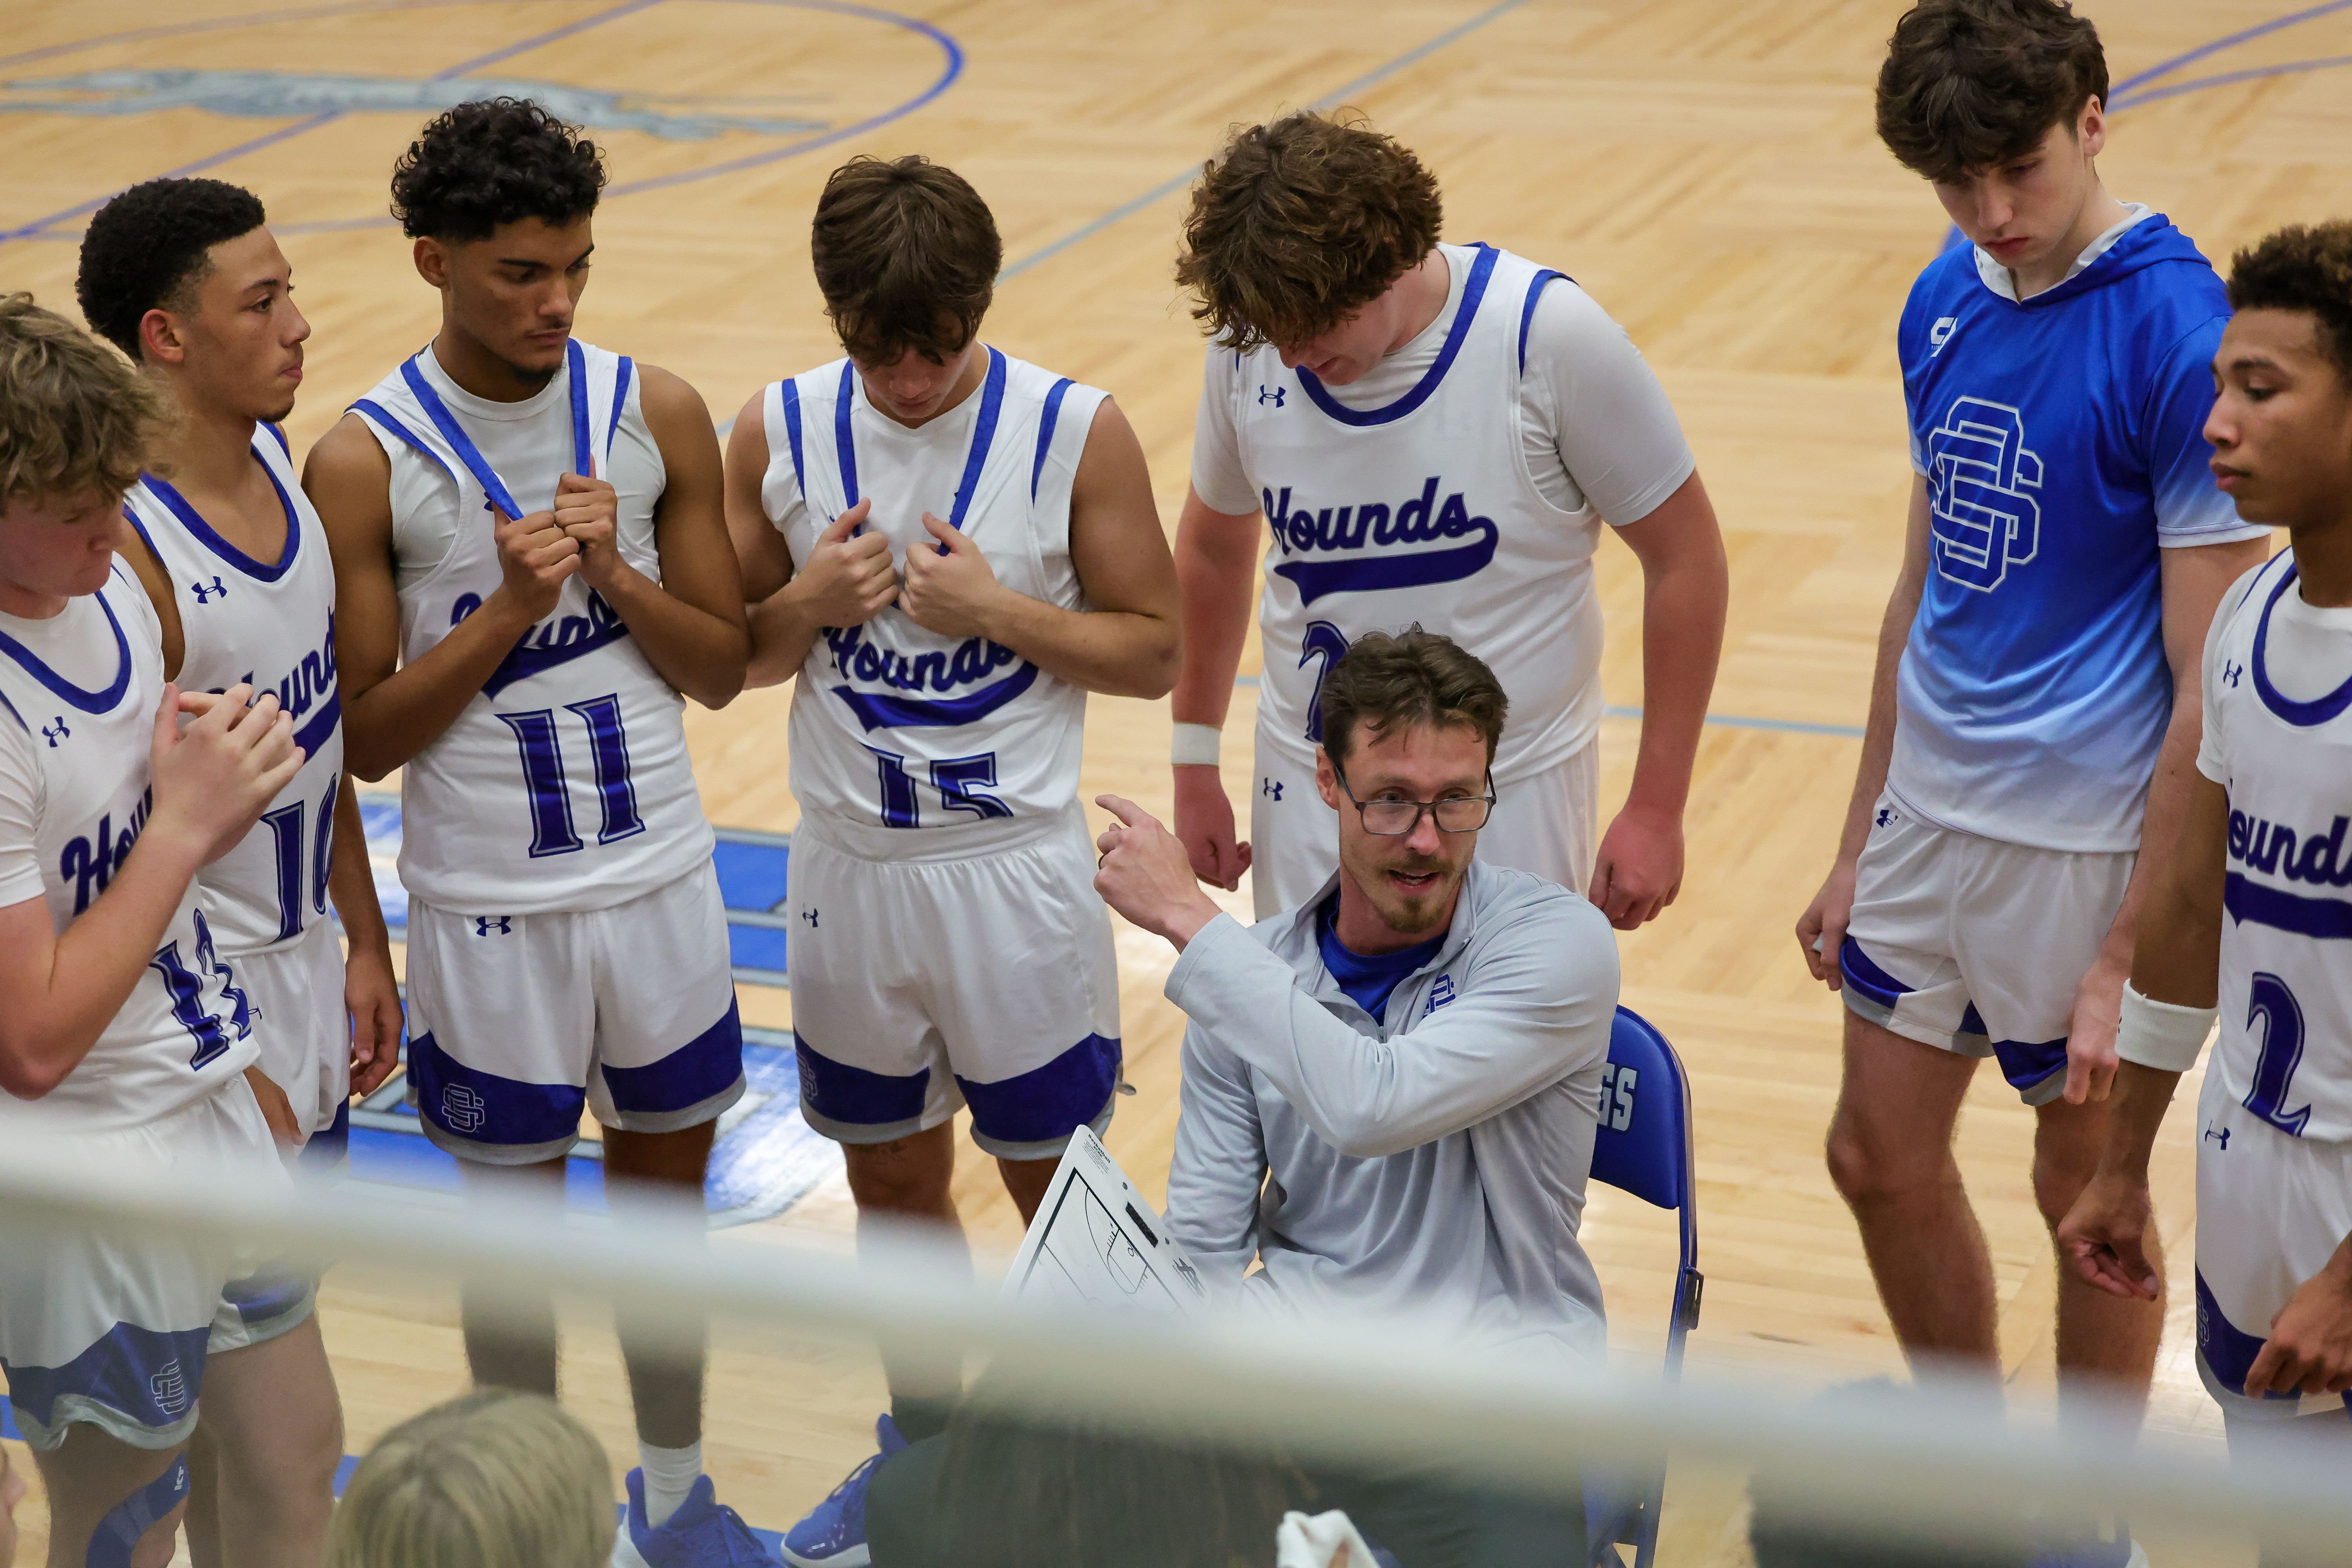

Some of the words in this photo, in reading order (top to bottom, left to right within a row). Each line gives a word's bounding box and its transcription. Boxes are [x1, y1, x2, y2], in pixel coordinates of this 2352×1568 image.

[1262, 475, 1472, 555] Hounds
[493, 692, 646, 858] 11
[859, 741, 1014, 828] 15
[2228, 809, 2352, 887] ound
[2242, 971, 2311, 1138] 2
[1597, 1061, 1639, 1134] GS
[1088, 1134, 1111, 1163] Basketball
